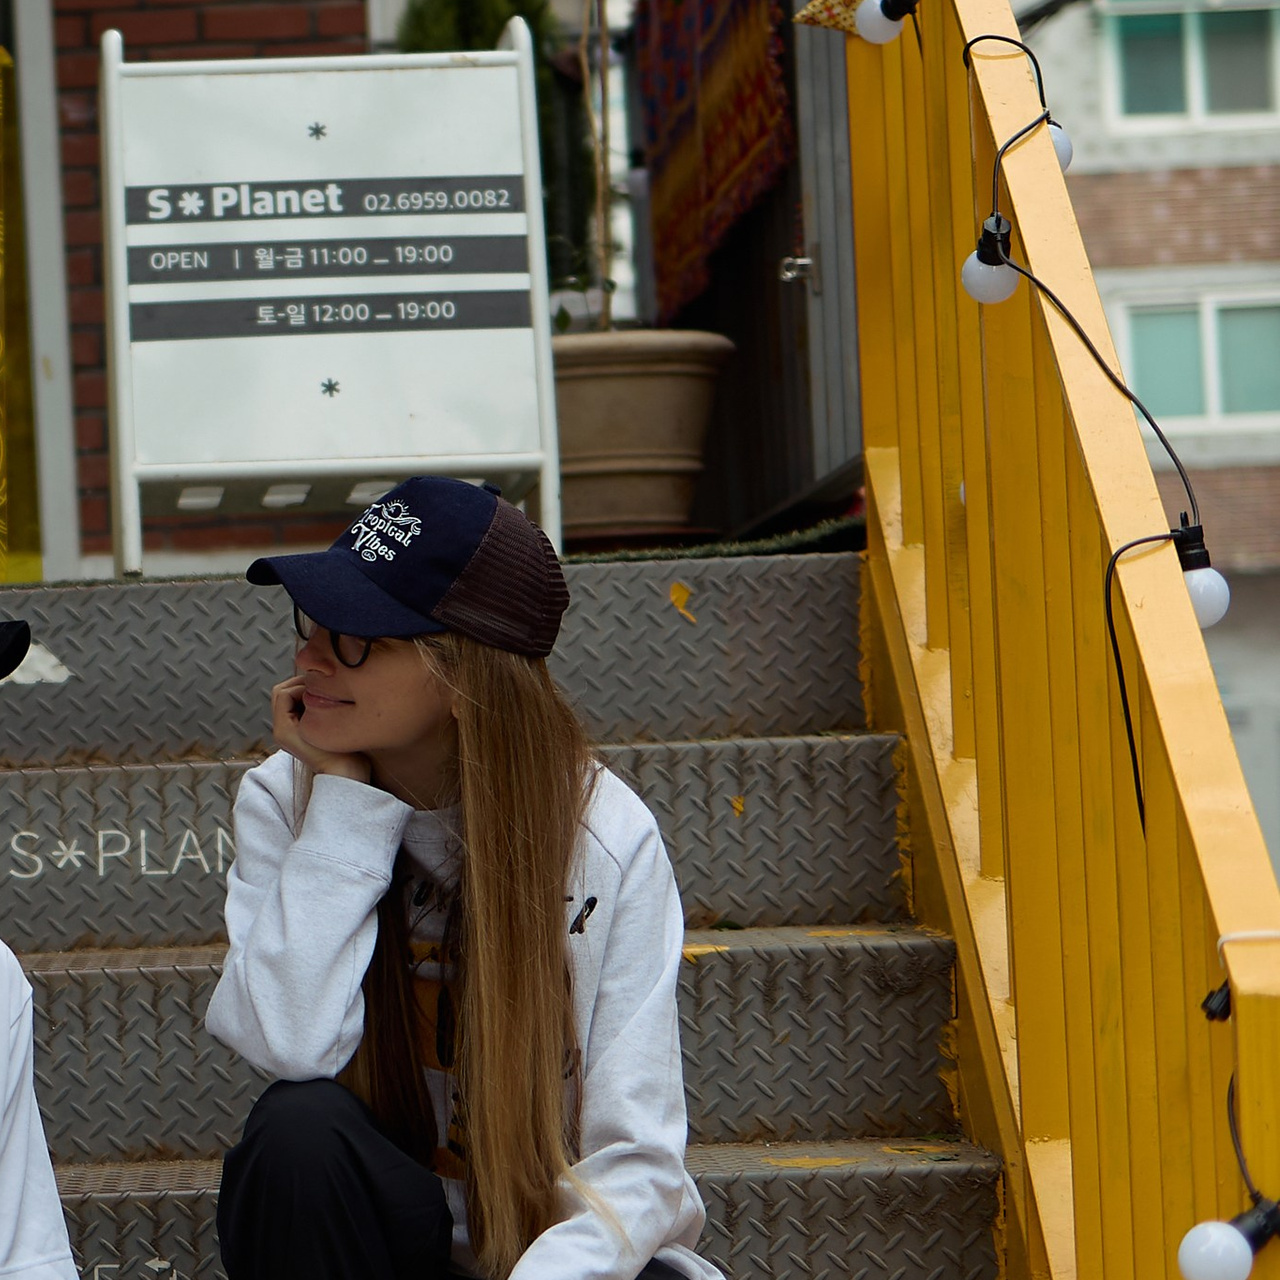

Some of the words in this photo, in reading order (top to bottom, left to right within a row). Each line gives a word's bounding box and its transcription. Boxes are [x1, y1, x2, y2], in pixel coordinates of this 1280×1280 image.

[364, 189, 511, 212] 02.6959.0082
[150, 250, 209, 270] OPEN
[255, 247, 304, 269] 월-금
[310, 246, 368, 266] 11:00
[395, 244, 454, 264] 19:00
[257, 303, 306, 326] 토-일
[312, 302, 370, 322] 12:00
[397, 300, 456, 319] 19:00
[351, 523, 397, 561] Vibes
